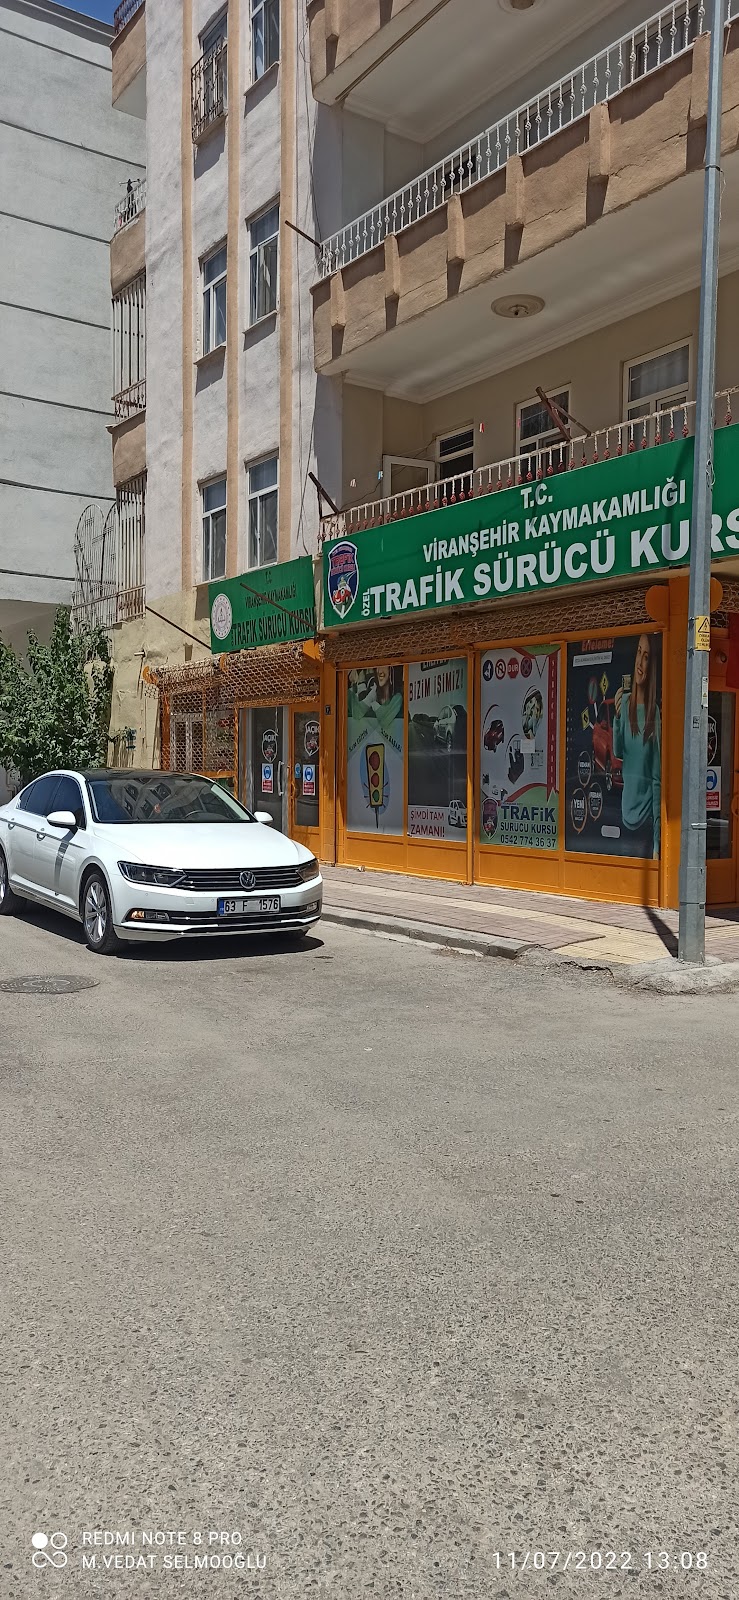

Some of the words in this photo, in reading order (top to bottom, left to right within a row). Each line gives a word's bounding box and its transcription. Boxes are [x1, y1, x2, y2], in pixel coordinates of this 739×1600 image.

[520, 482, 553, 509] T.C.
[423, 519, 520, 563] VİRANŞEHİR
[525, 476, 686, 540] KAYMAKAMLIĞI
[369, 565, 465, 614] TRAFİK
[473, 528, 616, 596] SÜRÜCÜ
[361, 588, 370, 617] ÖZEL
[410, 808, 429, 821] ŞİMDİ
[429, 811, 445, 821] TAM
[410, 824, 445, 838] ZAMANI!
[531, 823, 557, 835] KURSU
[500, 834, 518, 845] 0542
[519, 835, 534, 846] 774
[535, 837, 545, 848] 36
[546, 838, 557, 848] 37
[225, 900, 236, 912] 63
[242, 900, 248, 911] F
[258, 898, 279, 911] 1576
